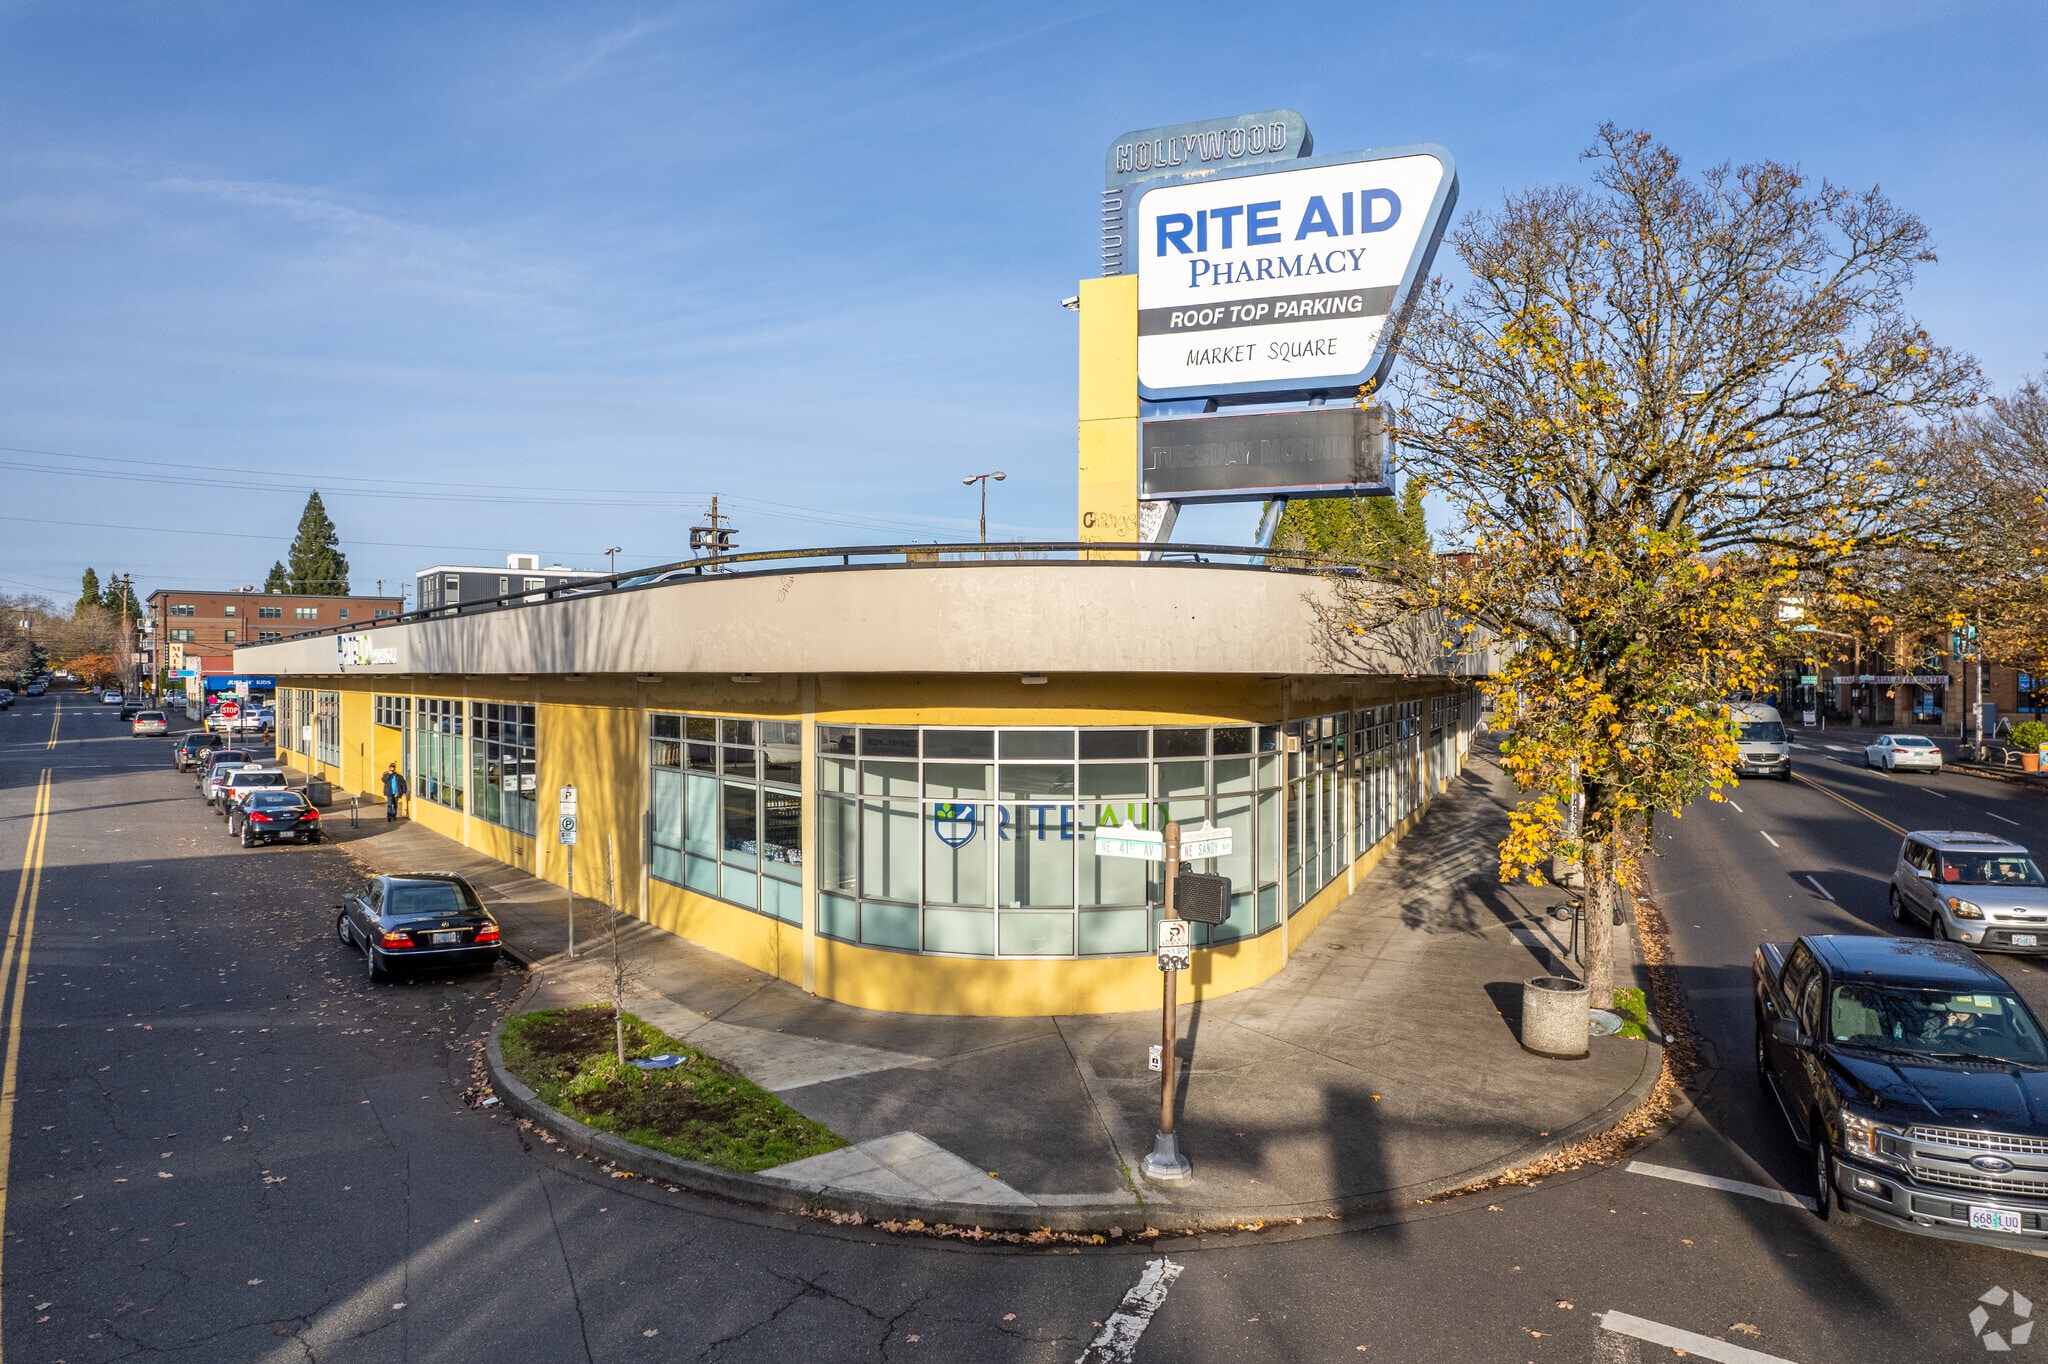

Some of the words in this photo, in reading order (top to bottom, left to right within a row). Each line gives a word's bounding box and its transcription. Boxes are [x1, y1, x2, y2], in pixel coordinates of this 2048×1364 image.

[1116, 122, 1287, 173] HOLLYWOOD
[1156, 200, 1282, 257] RITE
[1295, 188, 1403, 241] AID
[1170, 307, 1224, 328] ROOF
[1229, 304, 1269, 322] TOP
[1273, 295, 1363, 319] PARKING
[1186, 344, 1257, 367] MARKET
[1267, 337, 1338, 362] SQUARE
[984, 804, 1085, 841] RITE
[1101, 840, 1111, 852] NE
[1143, 844, 1154, 856] AV
[1184, 844, 1193, 858] NE
[1198, 841, 1219, 856] SANDY
[1973, 1211, 1993, 1224] 668
